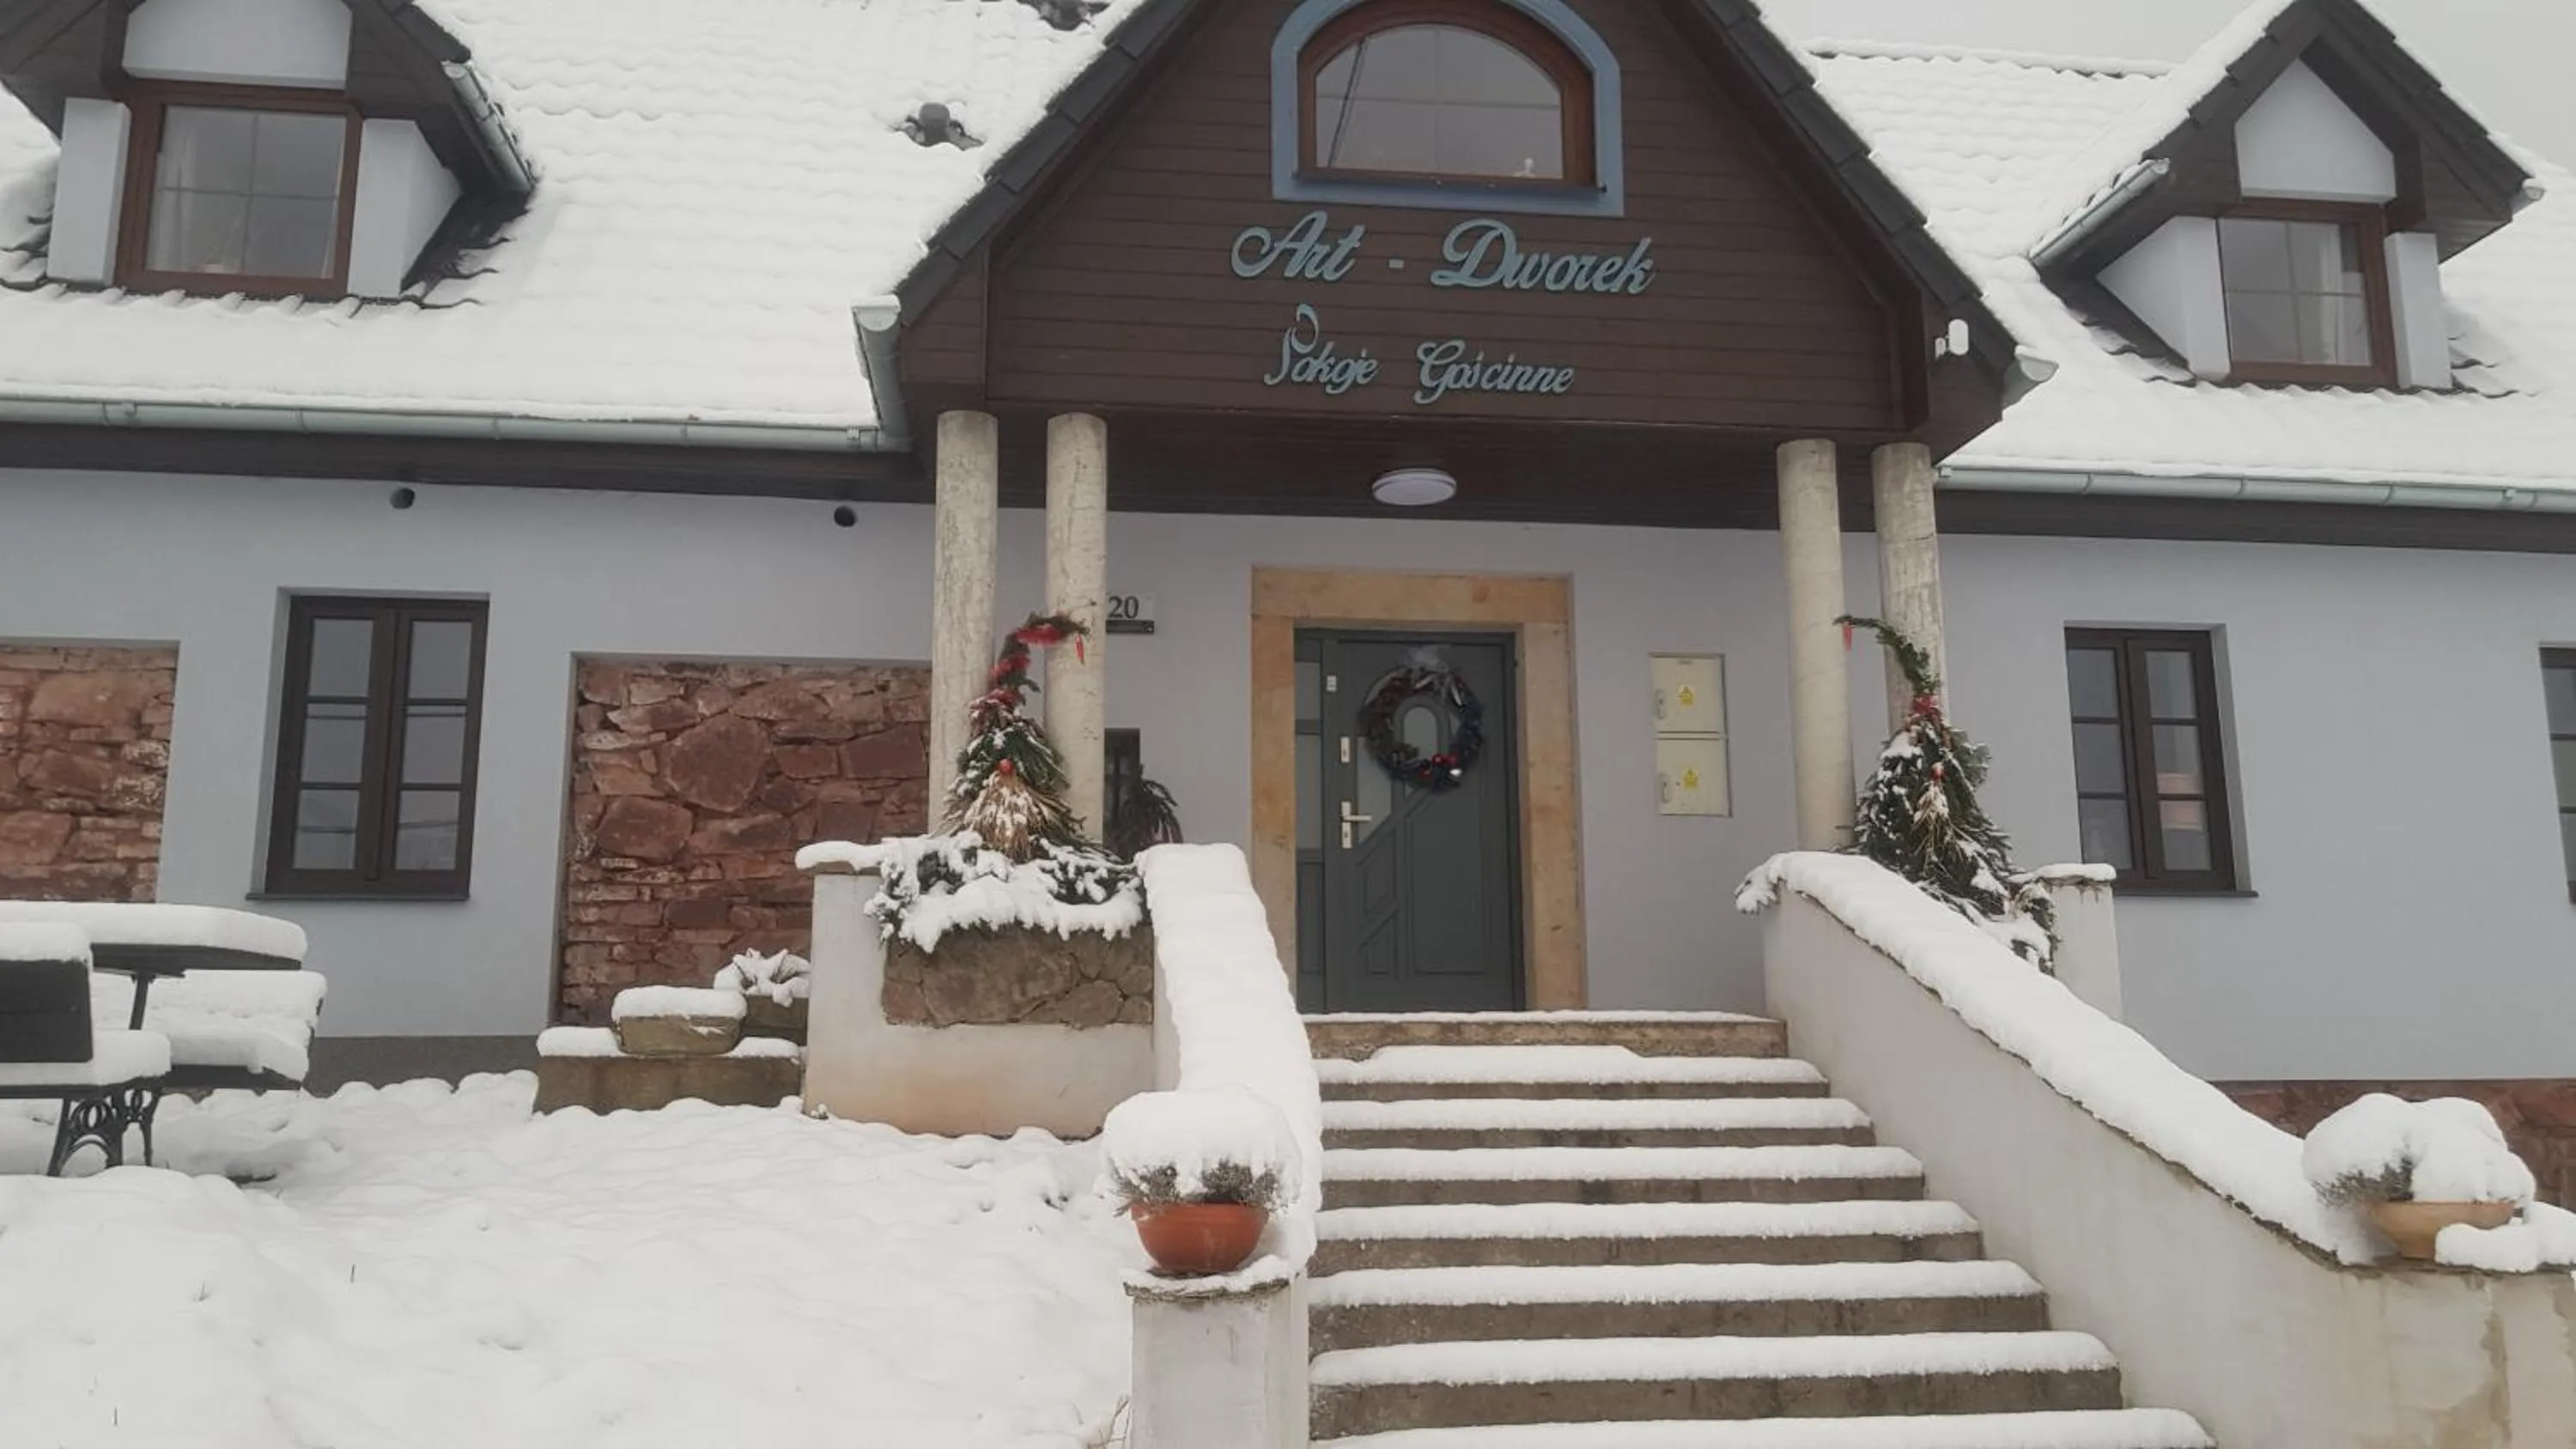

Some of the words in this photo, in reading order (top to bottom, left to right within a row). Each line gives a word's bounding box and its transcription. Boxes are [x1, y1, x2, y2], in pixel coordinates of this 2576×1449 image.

[1230, 210, 1365, 282] Art
[1431, 218, 1655, 294] Dworek
[1413, 339, 1575, 404] Gościnne
[1108, 595, 1139, 619] 20
